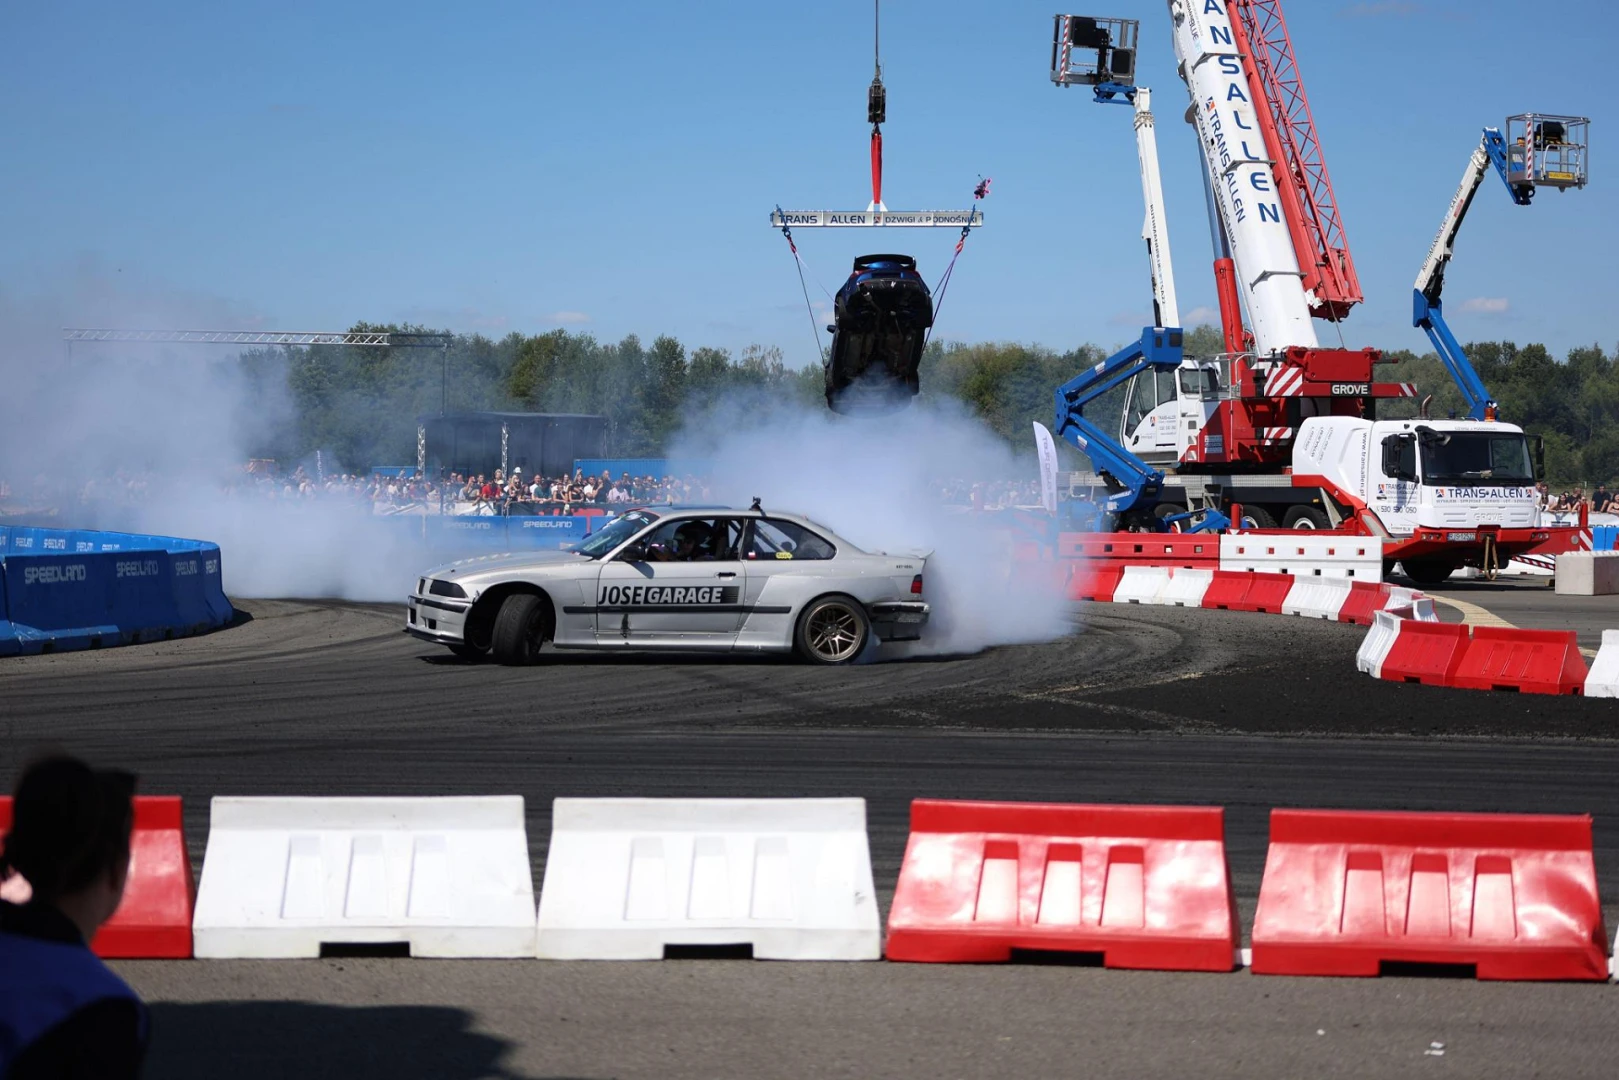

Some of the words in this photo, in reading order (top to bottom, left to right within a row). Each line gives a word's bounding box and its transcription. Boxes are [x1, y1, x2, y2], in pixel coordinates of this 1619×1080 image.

[779, 214, 818, 224] TRANS
[830, 214, 866, 224] ALLEN
[1332, 384, 1368, 395] GROVE
[25, 565, 86, 584] SPEEDLAND
[116, 560, 159, 578] SPEEDLAND
